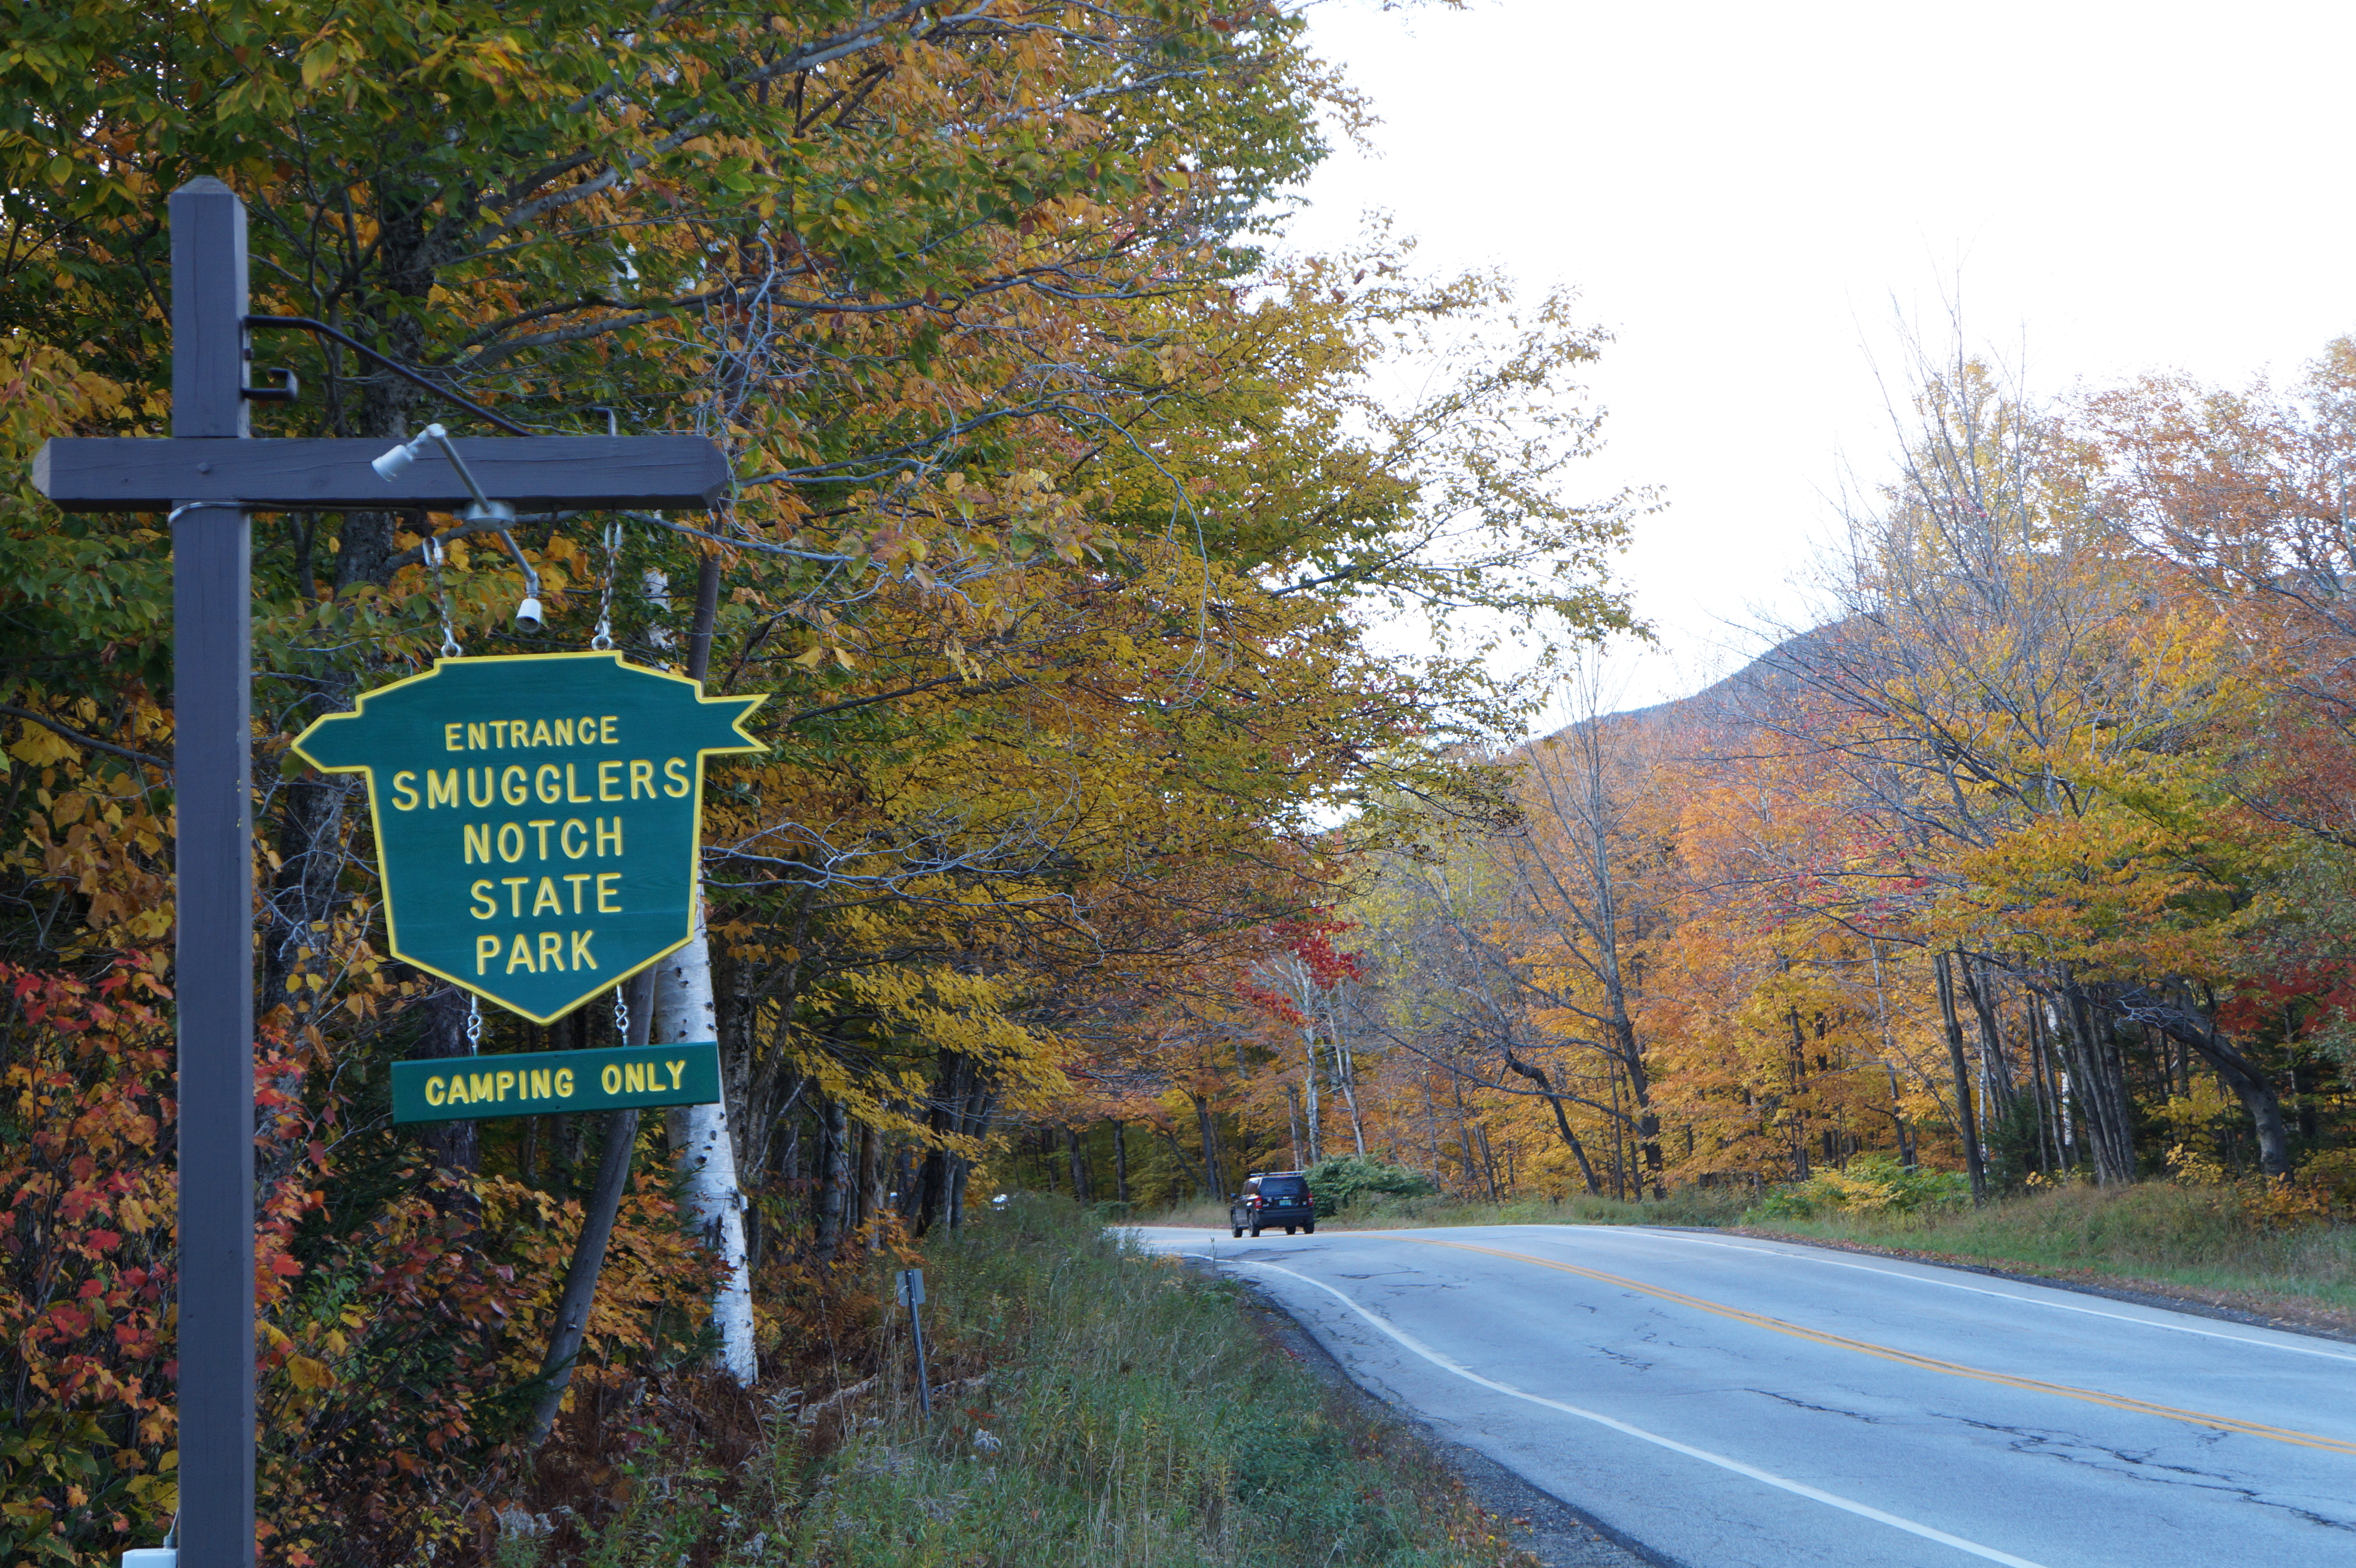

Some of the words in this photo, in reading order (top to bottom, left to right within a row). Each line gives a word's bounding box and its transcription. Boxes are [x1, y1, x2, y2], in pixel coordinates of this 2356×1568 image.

[444, 715, 619, 751] ENTRANCE
[391, 756, 690, 811] SMUGGLERS
[463, 816, 623, 864] NOTCH
[469, 872, 622, 920] STATE
[476, 929, 598, 975] PARK
[424, 1067, 574, 1106] CAMPING
[601, 1059, 686, 1094] ONLY
